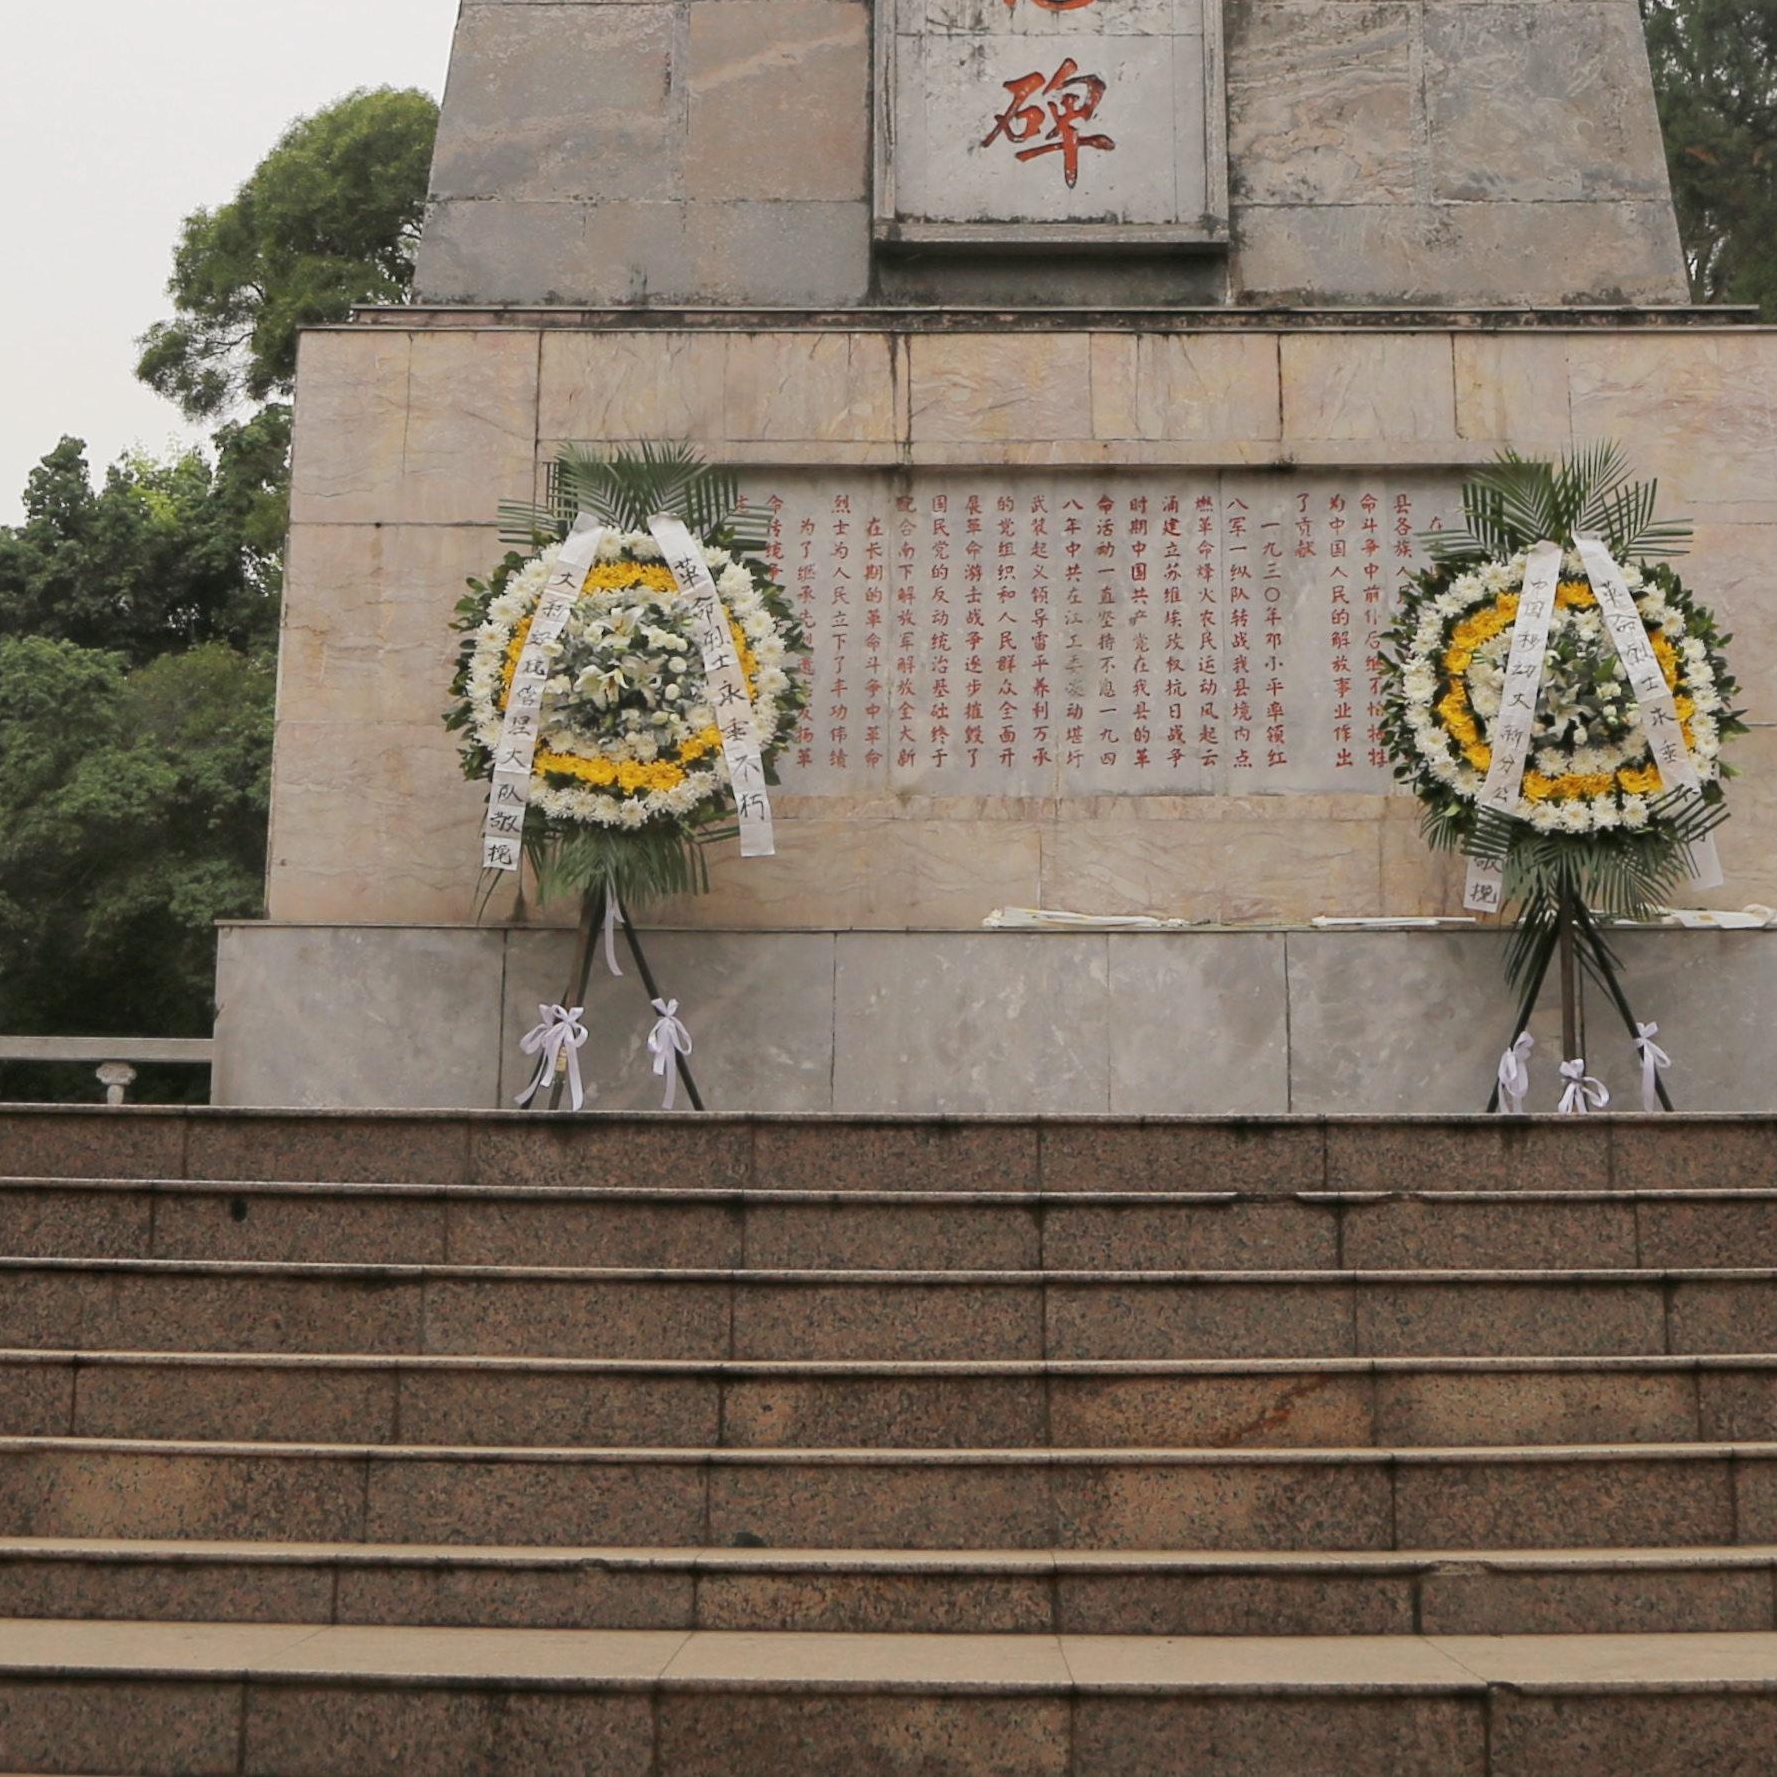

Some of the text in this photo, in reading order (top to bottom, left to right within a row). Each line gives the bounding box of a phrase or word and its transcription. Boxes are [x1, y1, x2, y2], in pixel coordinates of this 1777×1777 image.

[830, 494, 851, 768] 烈士为人民立下了丰功伟绩
[863, 517, 883, 768] 在长期的革命斗争中革命
[895, 495, 917, 768] 配合南下解放军解放全大新
[930, 494, 951, 768] 国民党的反动统治基础终于
[996, 495, 1018, 768] 的党组织和人民群众全面开
[1029, 495, 1052, 768] 武装起义领导雷平养利万承
[1095, 493, 1119, 767] 命活动一直坚持不息一九四
[1128, 495, 1151, 768] 时期中国共产党在我县的革
[1161, 495, 1187, 768] 涌建立苏维埃政权抗日战争
[1226, 496, 1253, 768] 八军一纵队转战我县境内点
[1293, 492, 1317, 559] 了贡献
[1328, 493, 1354, 768] 为中国人民的解放事业作出
[1469, 579, 1549, 906] 中国移动大新分公敬挽
